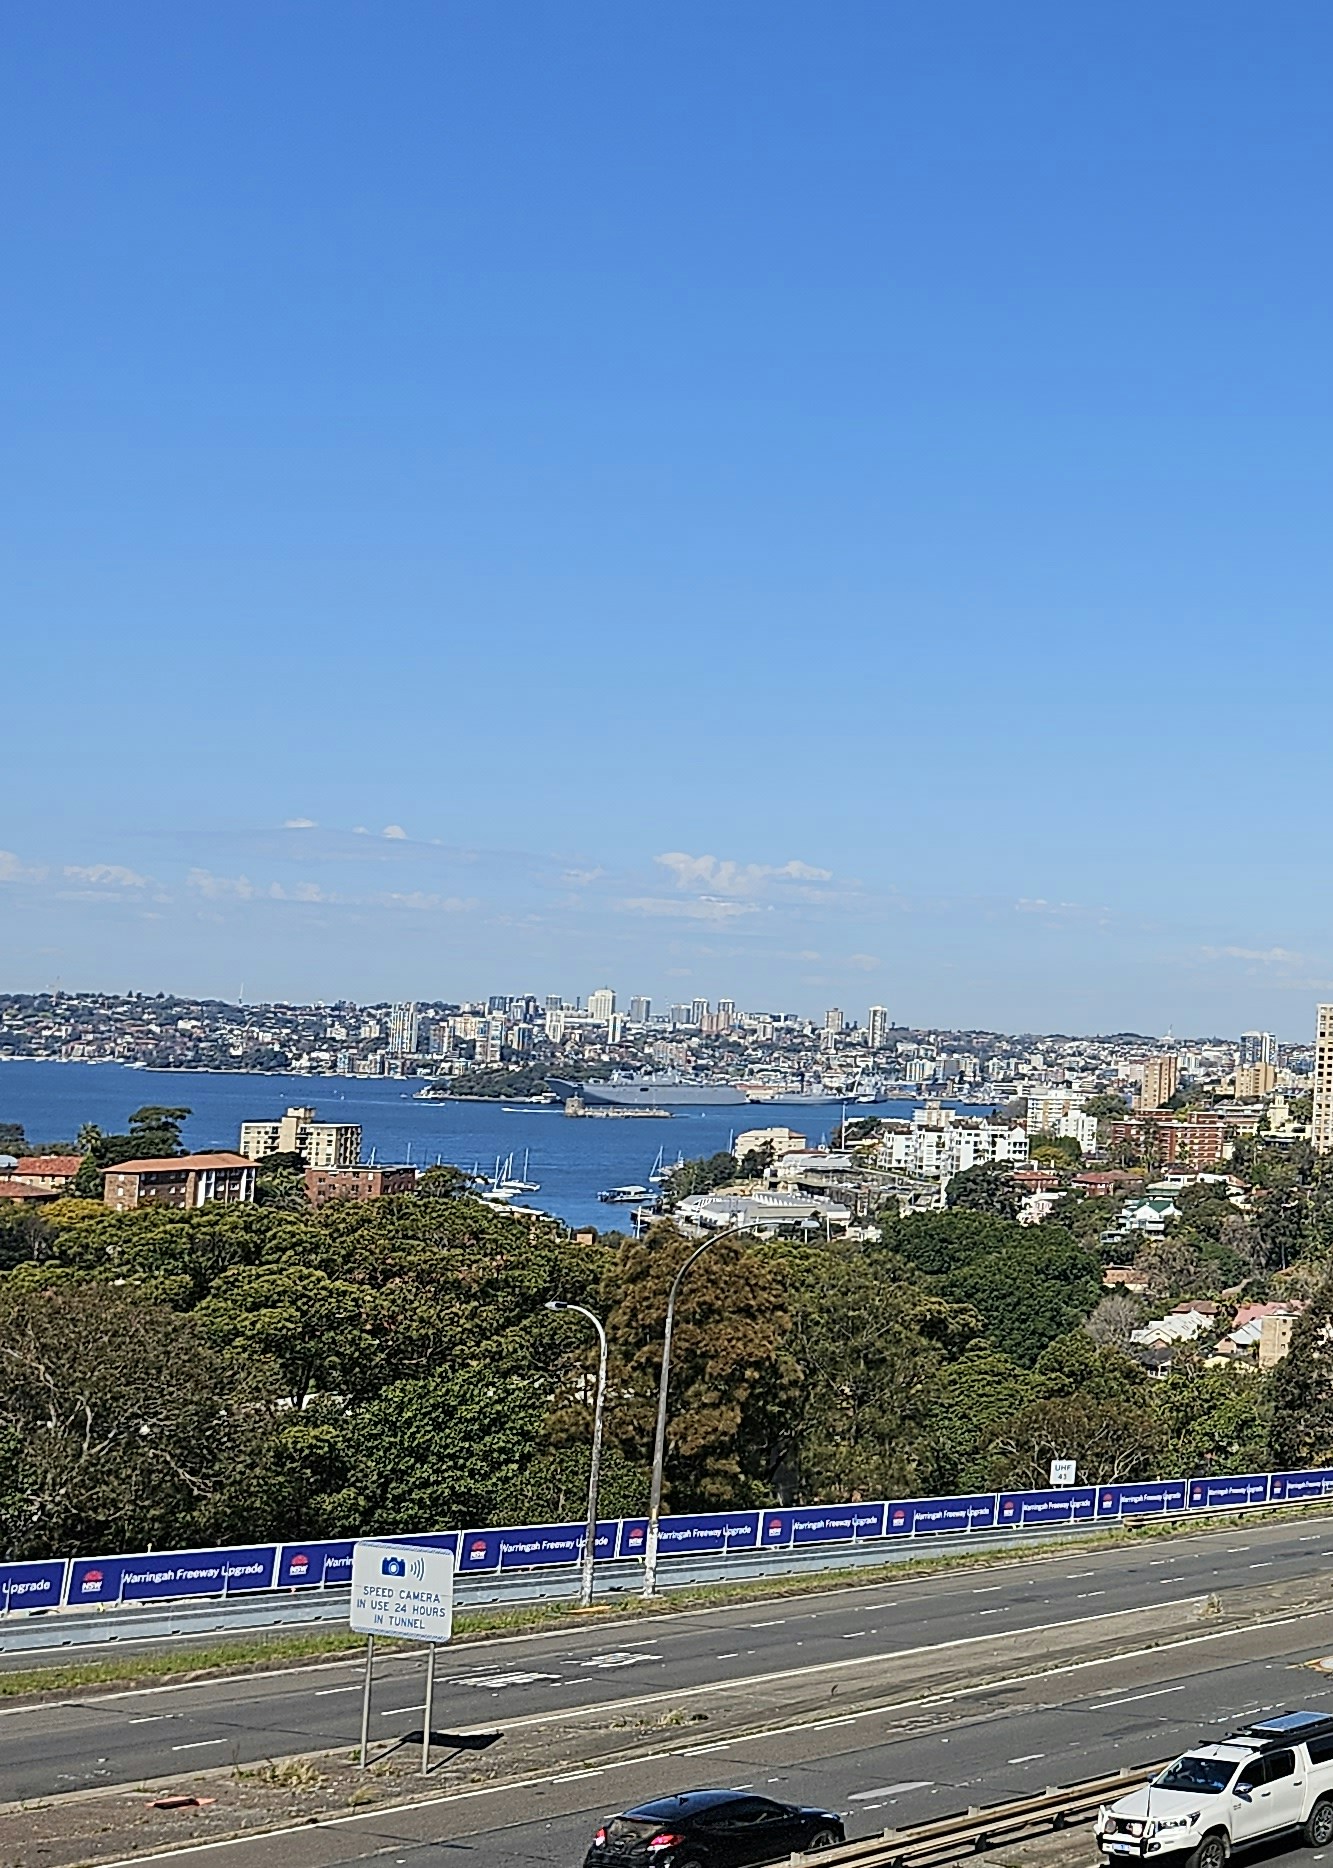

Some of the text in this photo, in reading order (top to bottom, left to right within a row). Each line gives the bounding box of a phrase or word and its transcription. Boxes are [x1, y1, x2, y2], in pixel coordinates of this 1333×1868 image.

[1054, 1464, 1072, 1472] UHF
[541, 1538, 575, 1550] Freeway
[576, 1535, 609, 1549] Upade
[325, 1556, 354, 1568] Warrin
[123, 1562, 264, 1584] Warringah Freeway Upgrade
[2, 1580, 51, 1595] Upgrade
[82, 1581, 103, 1591] NSW
[363, 1586, 440, 1603] SPEED CAMERA
[356, 1598, 446, 1618] IN USE 24 HOURS
[374, 1614, 426, 1630] IN TUNNEL
